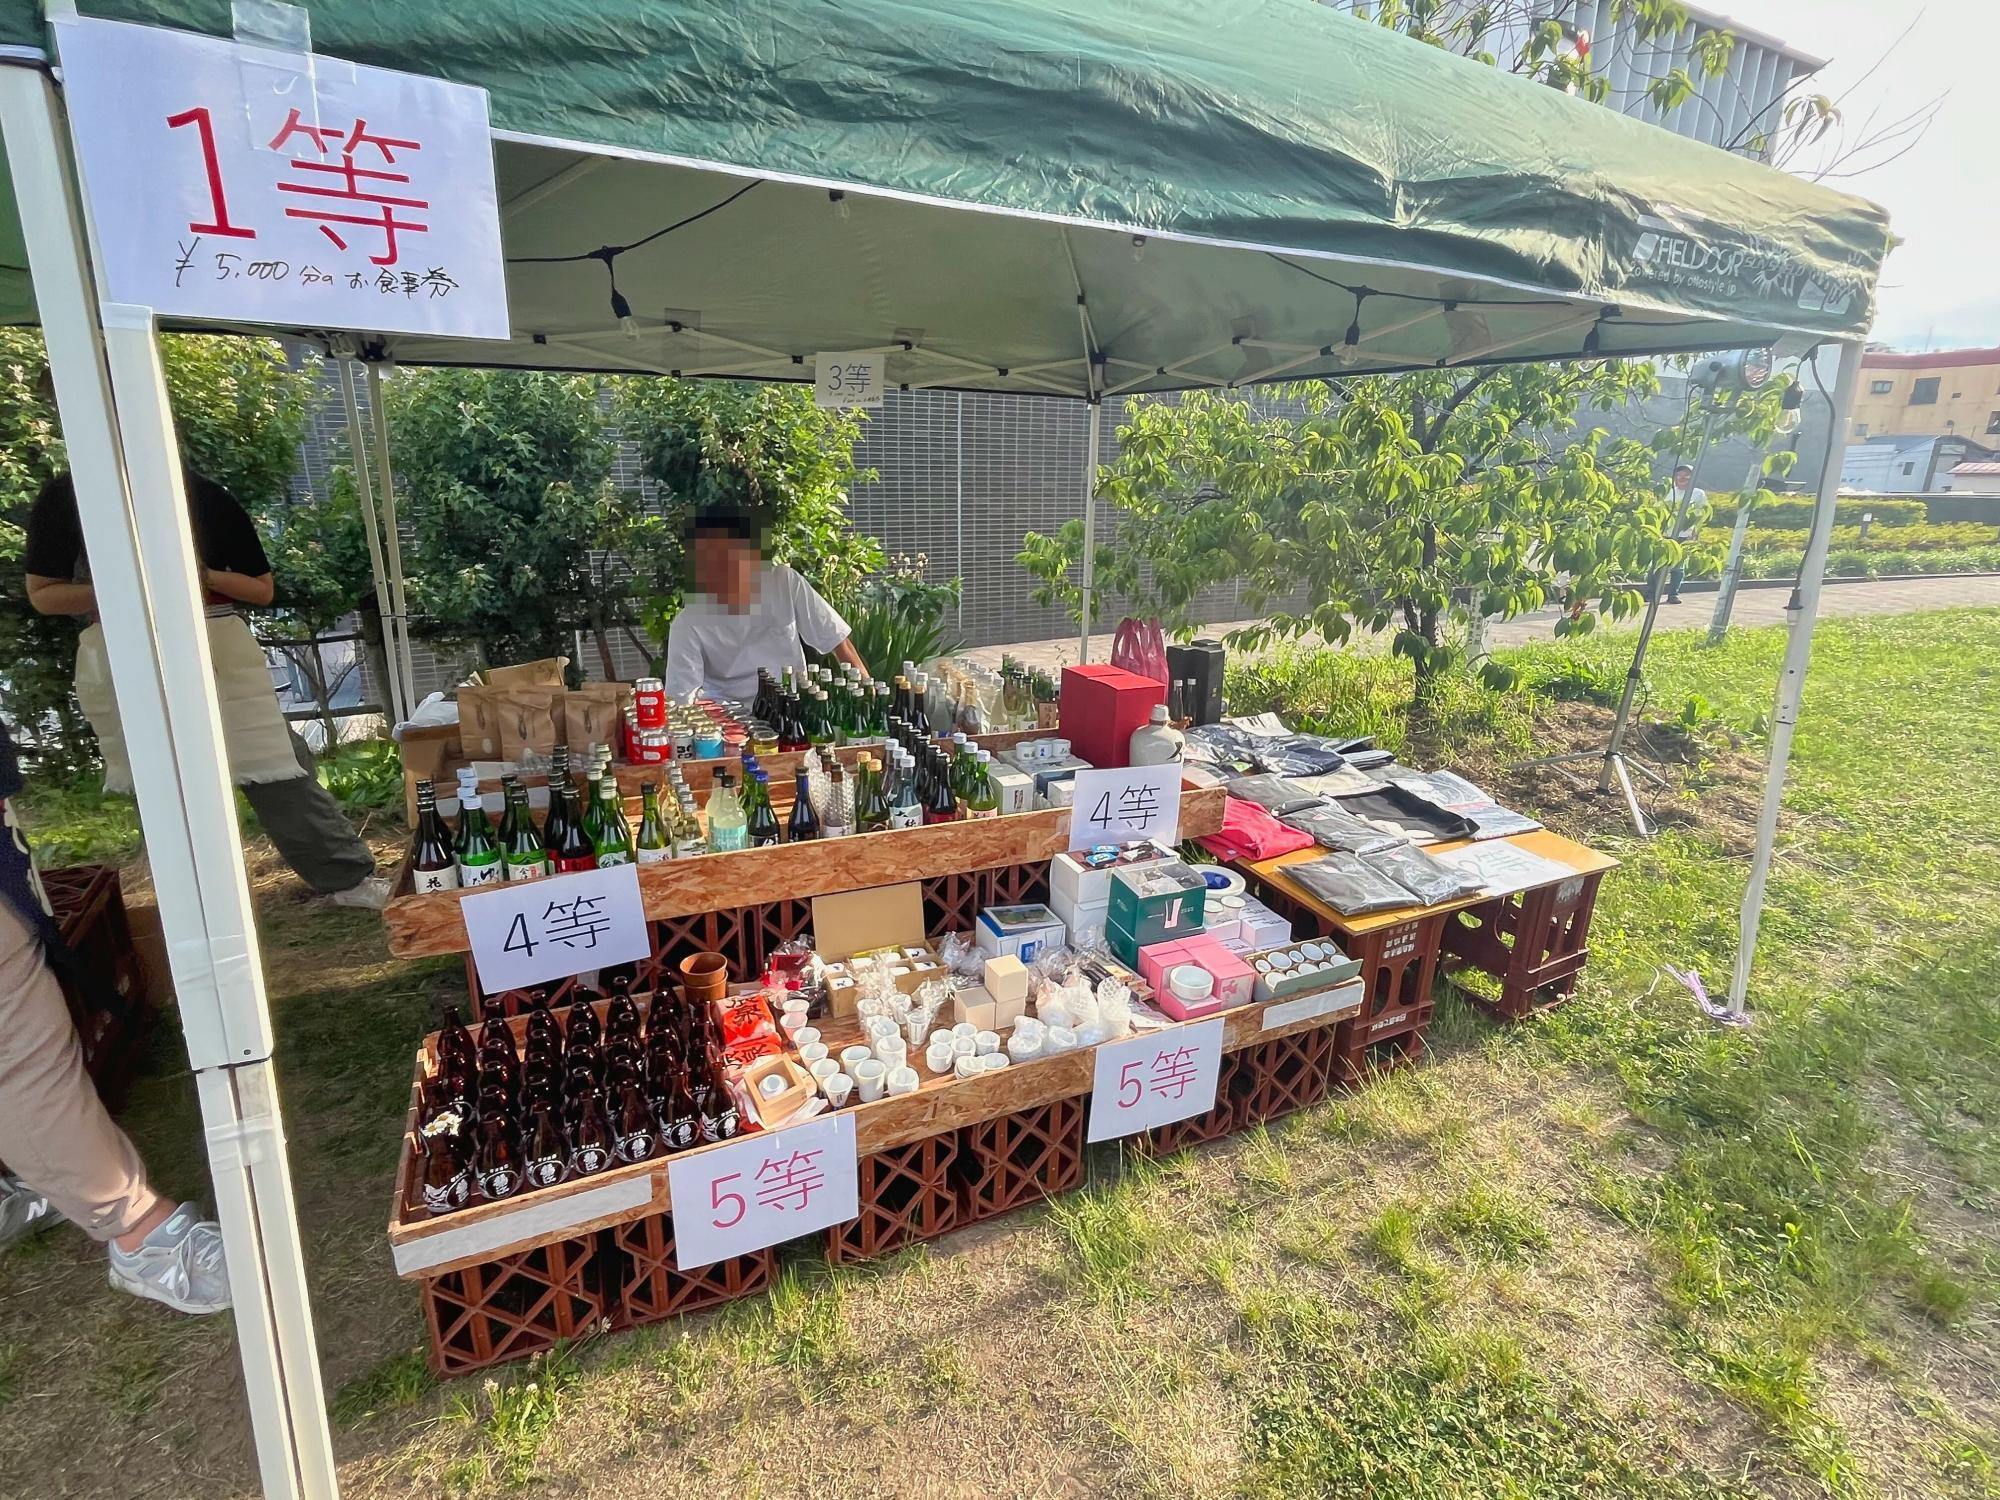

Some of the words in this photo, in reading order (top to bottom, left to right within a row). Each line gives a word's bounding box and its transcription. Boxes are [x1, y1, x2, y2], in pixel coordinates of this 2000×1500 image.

[167, 107, 429, 266] 1等
[828, 362, 872, 394] 3等
[1089, 783, 1162, 831] 4等
[503, 895, 611, 957] 4等
[1117, 1046, 1200, 1108] 5等
[710, 1149, 825, 1228] 5等
